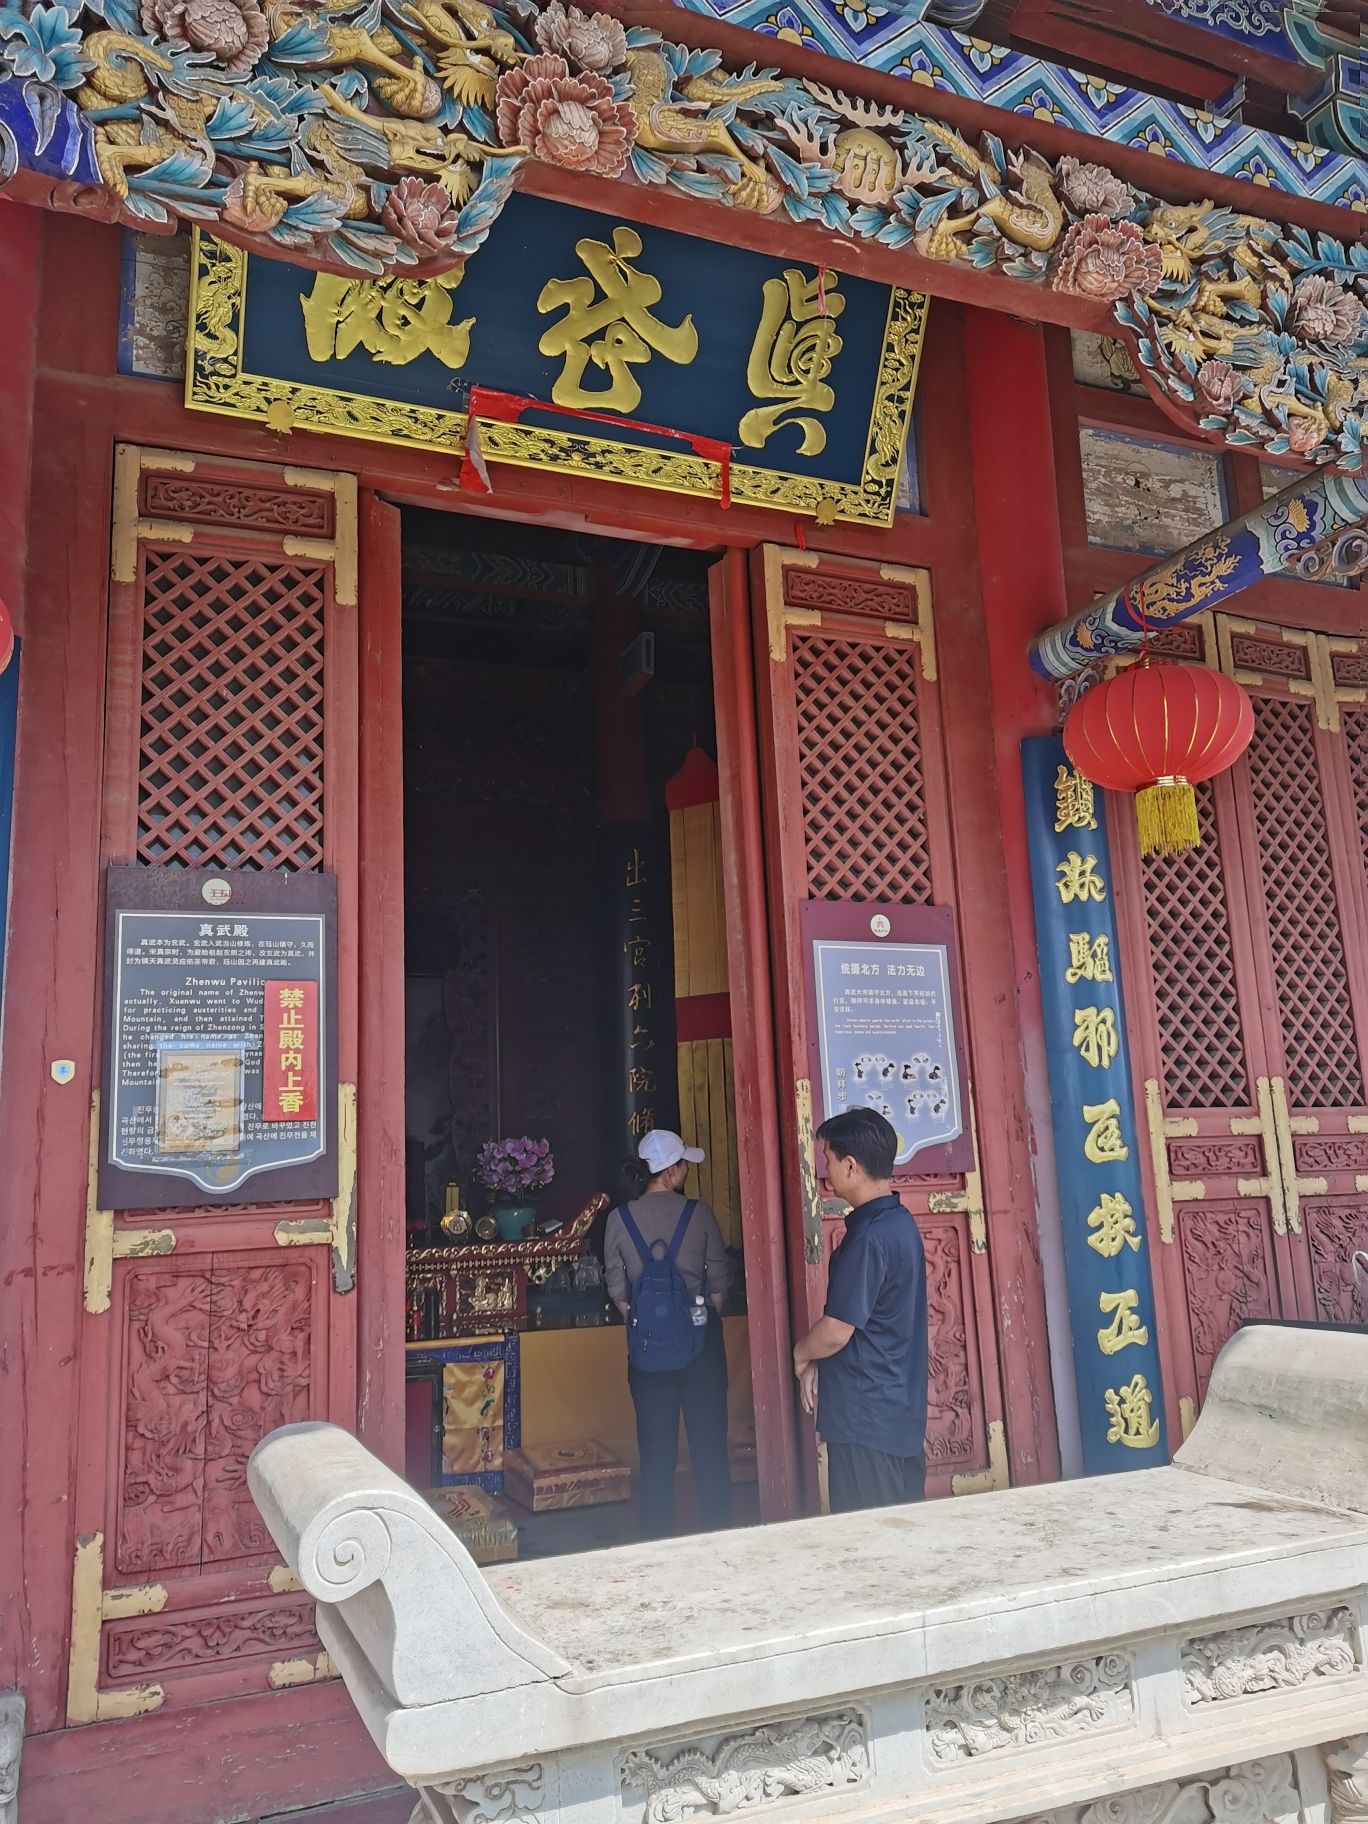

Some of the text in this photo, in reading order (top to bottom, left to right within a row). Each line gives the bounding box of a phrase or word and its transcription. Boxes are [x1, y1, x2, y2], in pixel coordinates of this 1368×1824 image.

[198, 923, 249, 937] 真武殿
[840, 962, 926, 977] 统摄北方 法力无边
[185, 977, 265, 986] Zhenwu Pavilio
[140, 988, 155, 996] The
[161, 988, 193, 998] original
[225, 988, 233, 996] of
[239, 988, 264, 996] Zhenw
[123, 1006, 257, 1015] for practicing austerities and
[123, 1015, 166, 1023] Mountain,
[174, 1015, 188, 1023] and
[195, 1015, 213, 1023] then
[220, 1015, 253, 1023] attained
[123, 1024, 151, 1033] During
[154, 1024, 168, 1032] the
[171, 1024, 192, 1033] reign
[195, 1024, 204, 1032] of
[207, 1024, 245, 1033] Zhenzong
[249, 1024, 257, 1032] in
[122, 1033, 133, 1041] he
[140, 1033, 174, 1042] changed
[122, 1042, 154, 1050] sharing
[278, 988, 305, 1113] 禁止殿内上香
[123, 1051, 141, 1059] (the
[145, 1051, 160, 1059] firs
[122, 1060, 141, 1068] then
[121, 1069, 160, 1078] Therefor
[121, 1079, 160, 1087] Mountai
